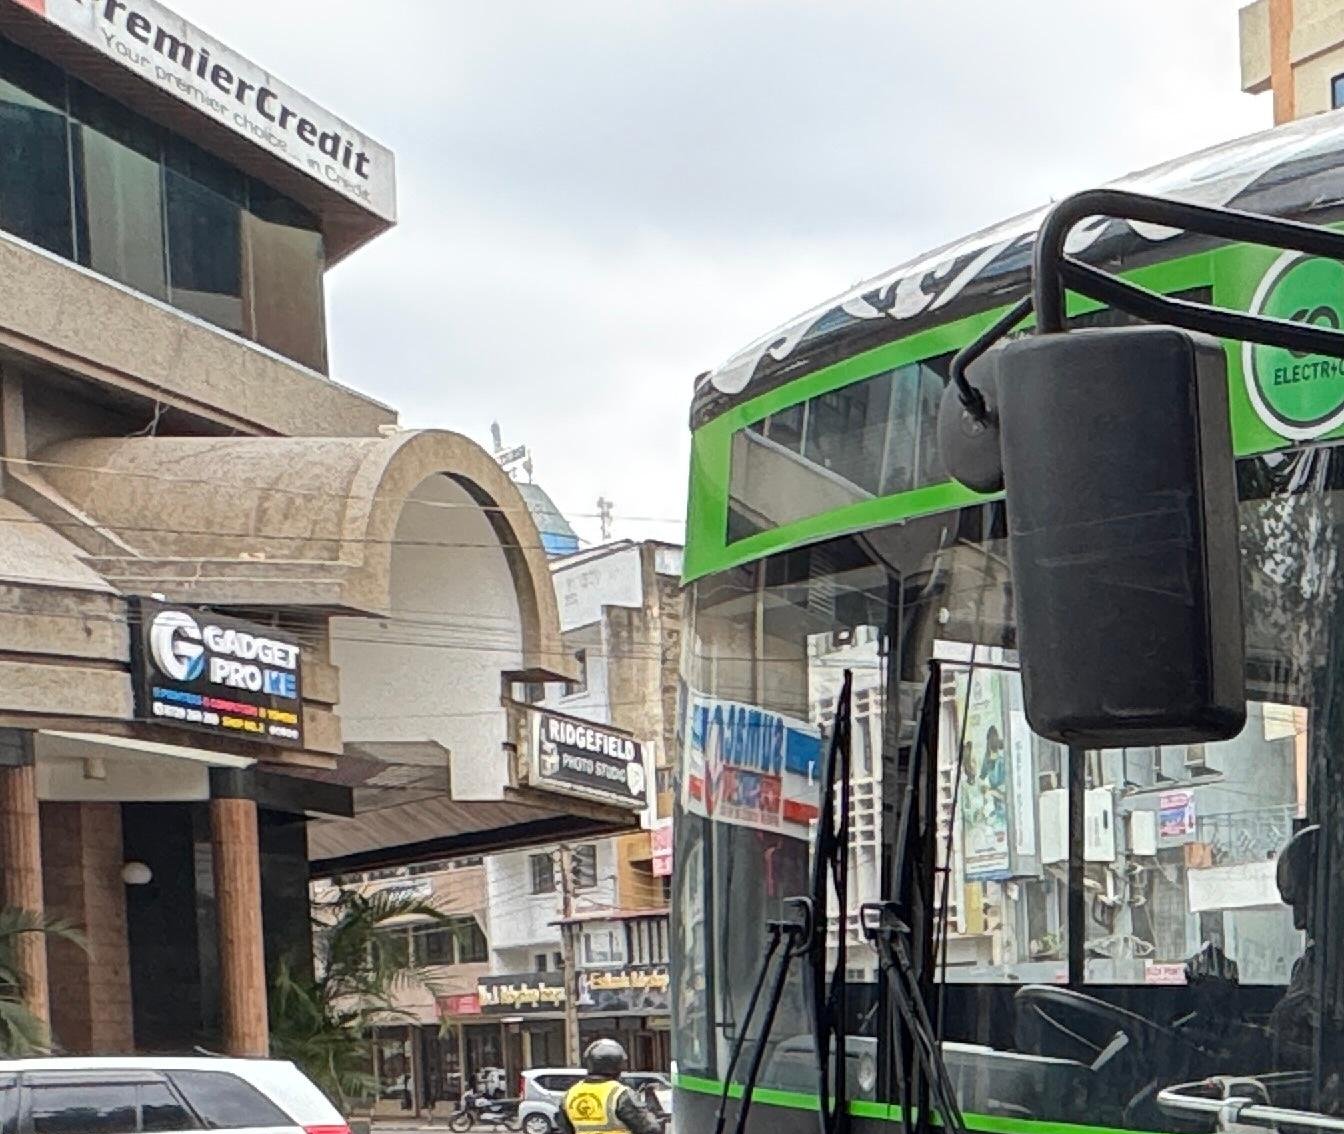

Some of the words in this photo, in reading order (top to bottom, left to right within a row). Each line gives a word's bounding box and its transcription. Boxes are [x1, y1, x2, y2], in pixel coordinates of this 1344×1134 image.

[77, 0, 371, 180] remierCredit
[101, 27, 151, 64] Your
[155, 64, 229, 117] premier
[324, 163, 371, 204] Credit
[203, 625, 300, 669] GADGET
[550, 718, 636, 761] RIDGEFIELD
[563, 752, 594, 775] PHOTO
